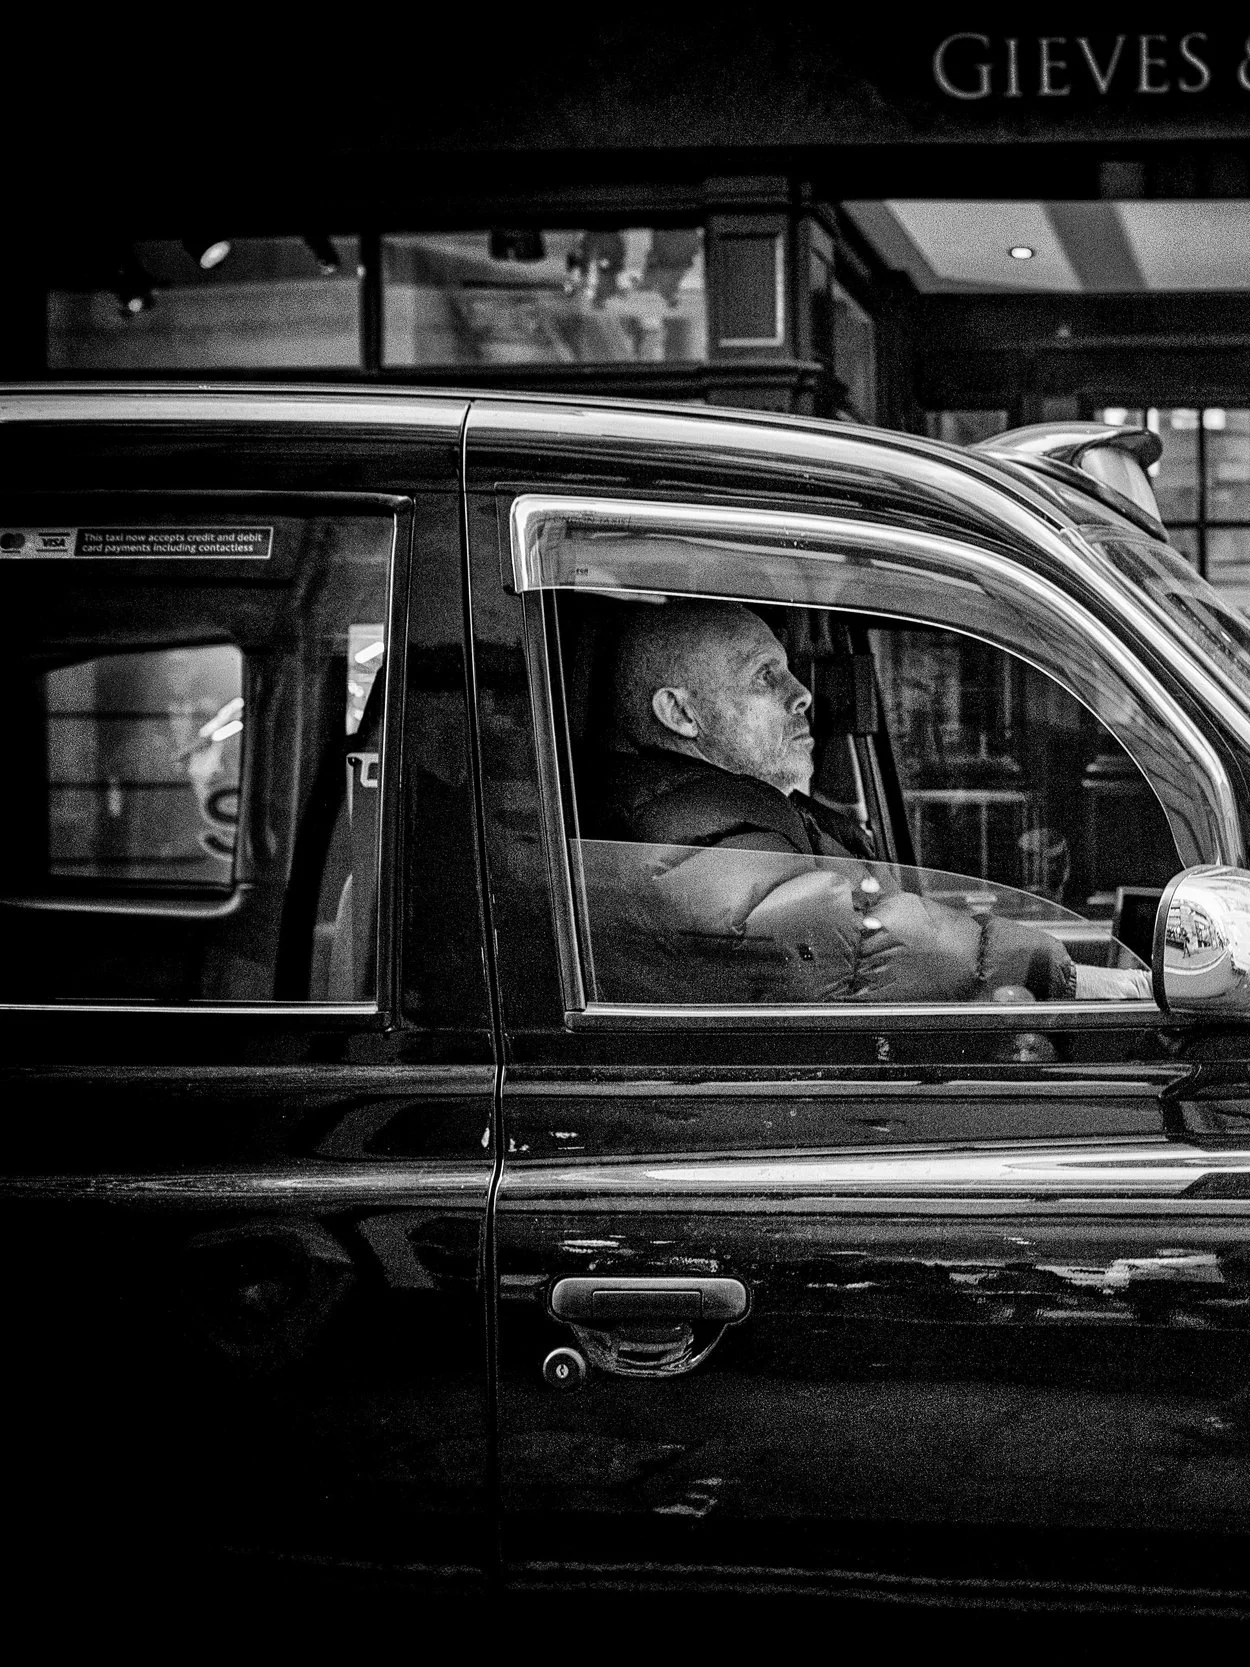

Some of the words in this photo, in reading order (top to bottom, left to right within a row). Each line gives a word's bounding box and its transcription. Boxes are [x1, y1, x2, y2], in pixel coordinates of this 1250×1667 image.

[932, 31, 1211, 100] GIEVES
[42, 538, 66, 548] VISA
[84, 532, 103, 542] This
[105, 532, 124, 542] taxi
[125, 534, 146, 542] now
[148, 533, 185, 543] accepts
[187, 532, 215, 542] credit
[216, 532, 235, 542] and
[237, 532, 262, 542] debit
[82, 543, 103, 553] card
[104, 544, 151, 554] payments
[153, 543, 196, 554] including
[198, 543, 254, 553] contactless
